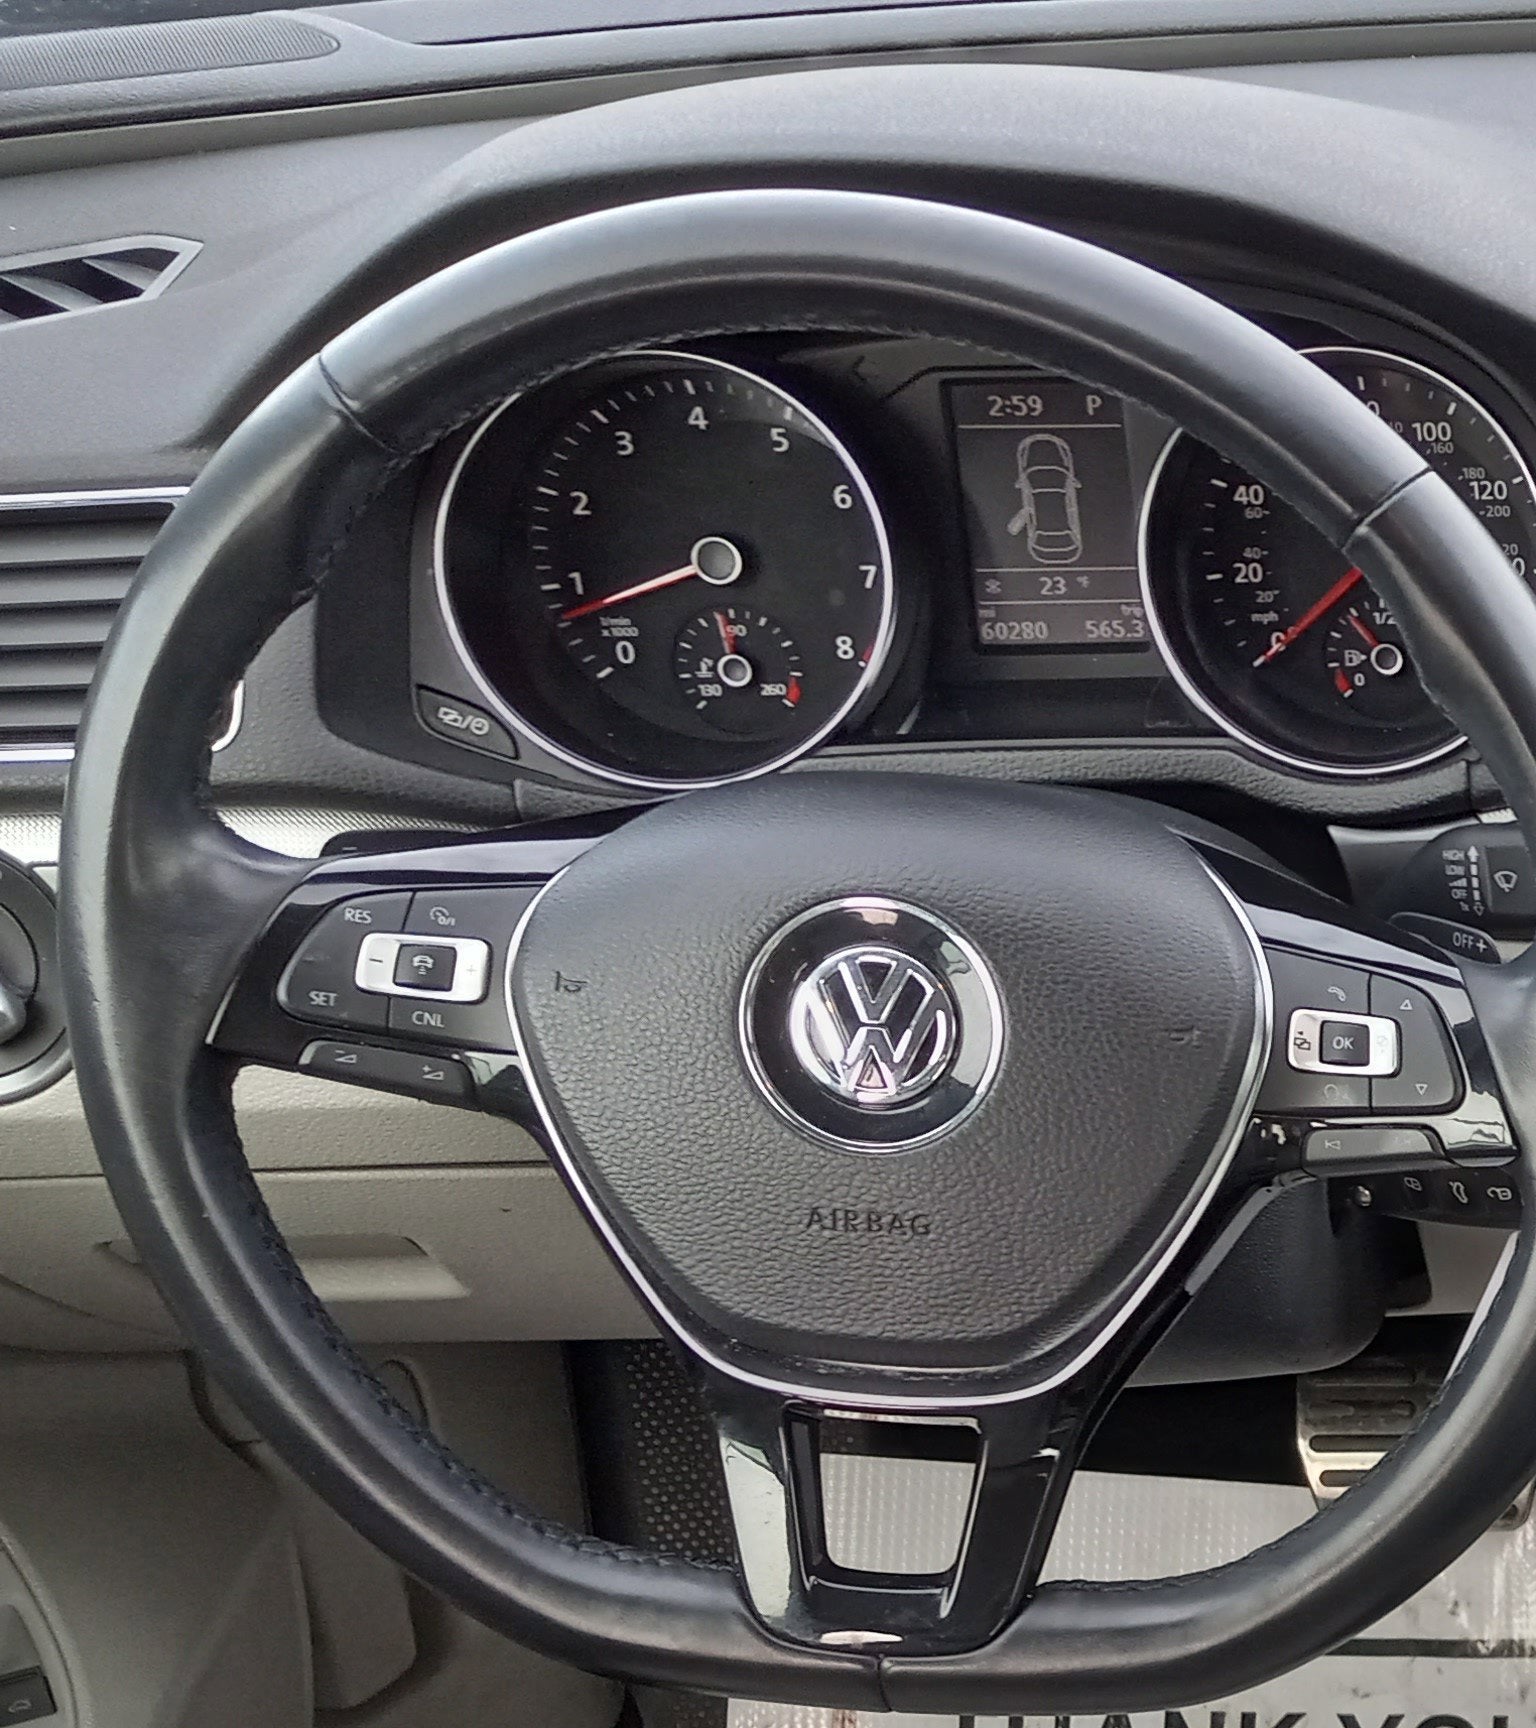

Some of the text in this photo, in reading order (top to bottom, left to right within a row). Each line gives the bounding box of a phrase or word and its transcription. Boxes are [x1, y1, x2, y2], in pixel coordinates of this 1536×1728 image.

[988, 394, 1101, 417] 2:59 P
[687, 406, 708, 430] 4
[769, 427, 790, 451] 5
[1412, 421, 1452, 442] 100
[616, 431, 634, 456] 3
[1430, 442, 1453, 454] 160
[1461, 467, 1485, 479] 180
[833, 485, 852, 509] 6
[1233, 484, 1264, 505] 40
[1469, 480, 1507, 500] 120
[571, 492, 591, 516] 2
[1245, 508, 1263, 518] 60
[1486, 505, 1511, 517] 200
[1243, 548, 1261, 558] 40
[569, 572, 583, 594] 1
[859, 565, 877, 589] 7
[1233, 563, 1263, 583] 20
[1039, 577, 1067, 595] 23
[1255, 591, 1274, 602] 20
[981, 619, 1145, 640] 60280 565.3
[615, 641, 636, 664] 0
[836, 636, 854, 660] 8
[1354, 673, 1365, 686] 0
[760, 683, 787, 697] 260
[344, 908, 372, 924] RES
[308, 990, 337, 1007] SET
[412, 1010, 445, 1028] CNL
[1332, 1036, 1354, 1051] OK
[806, 1206, 932, 1236] AIRBAG
